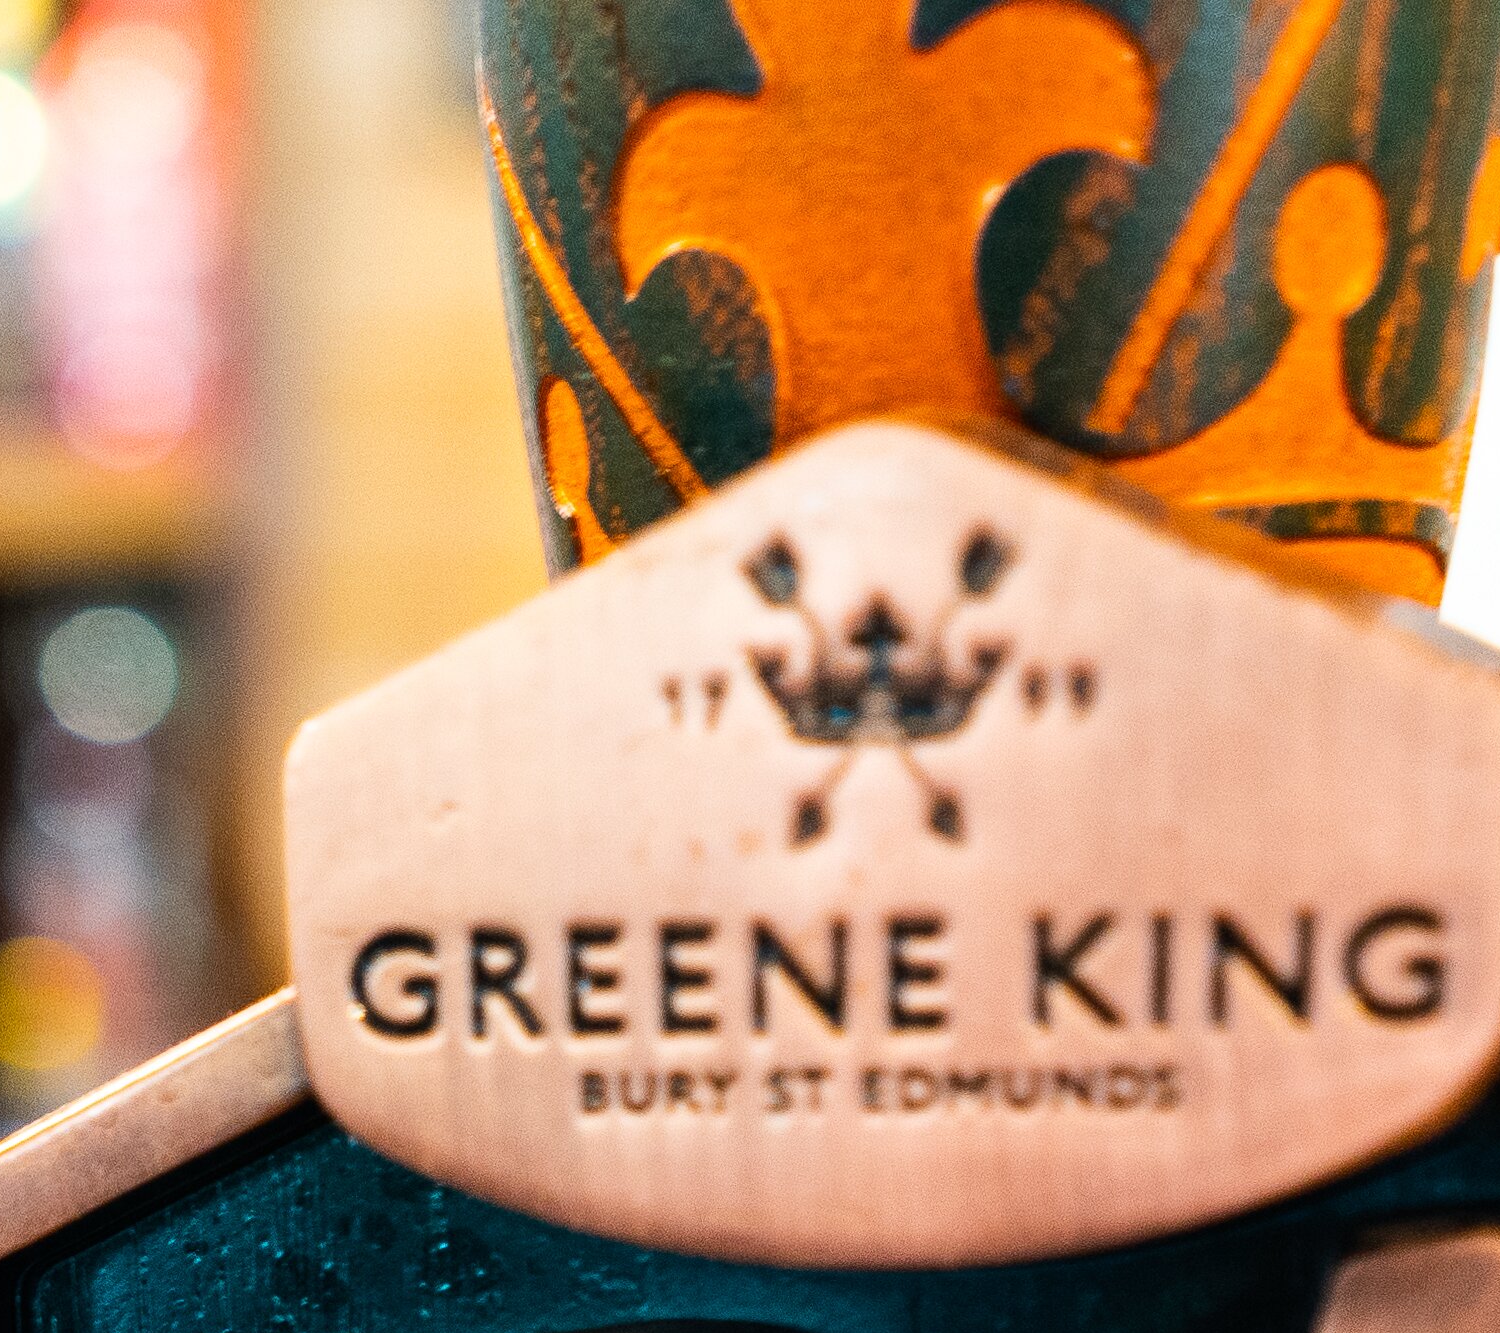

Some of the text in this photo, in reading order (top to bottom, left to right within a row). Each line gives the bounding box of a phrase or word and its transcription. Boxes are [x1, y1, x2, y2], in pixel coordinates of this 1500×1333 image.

[347, 906, 1452, 1042] GREENE KING
[577, 1060, 1185, 1118] BURY ST EDMUNDS
